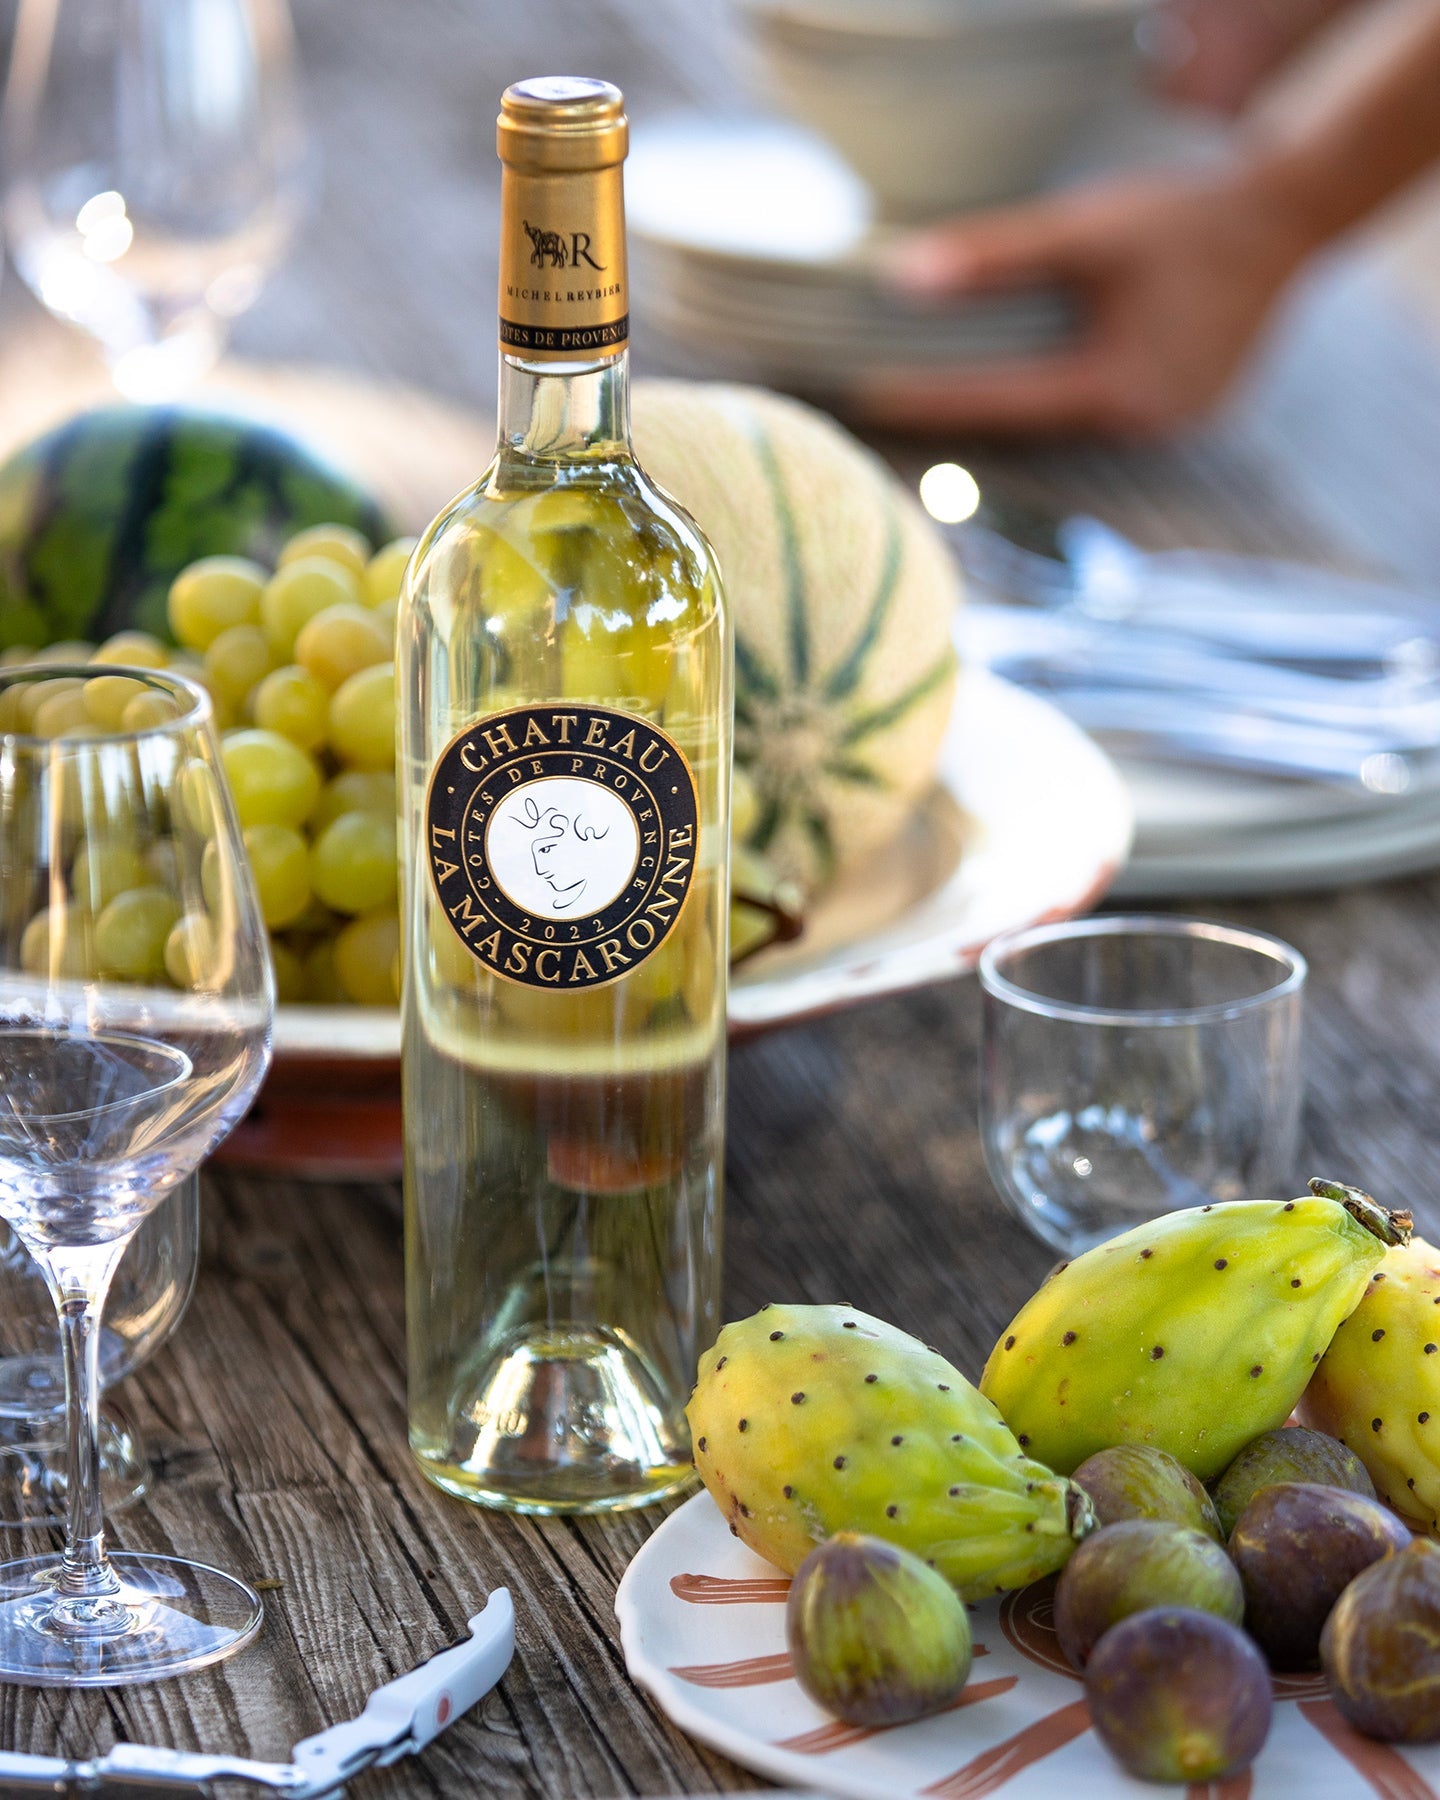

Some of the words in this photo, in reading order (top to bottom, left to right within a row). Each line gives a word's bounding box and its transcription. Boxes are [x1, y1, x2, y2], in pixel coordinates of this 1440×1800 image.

[507, 285, 562, 301] MICHEL
[566, 283, 621, 302] REYBIER
[534, 332, 554, 346] DE
[459, 715, 671, 773] CHATEAU
[507, 759, 544, 784] DE
[571, 758, 657, 890] PROVENCE
[432, 823, 460, 885] LA
[449, 823, 693, 983] MASCARONNE
[519, 918, 605, 940] 2022
